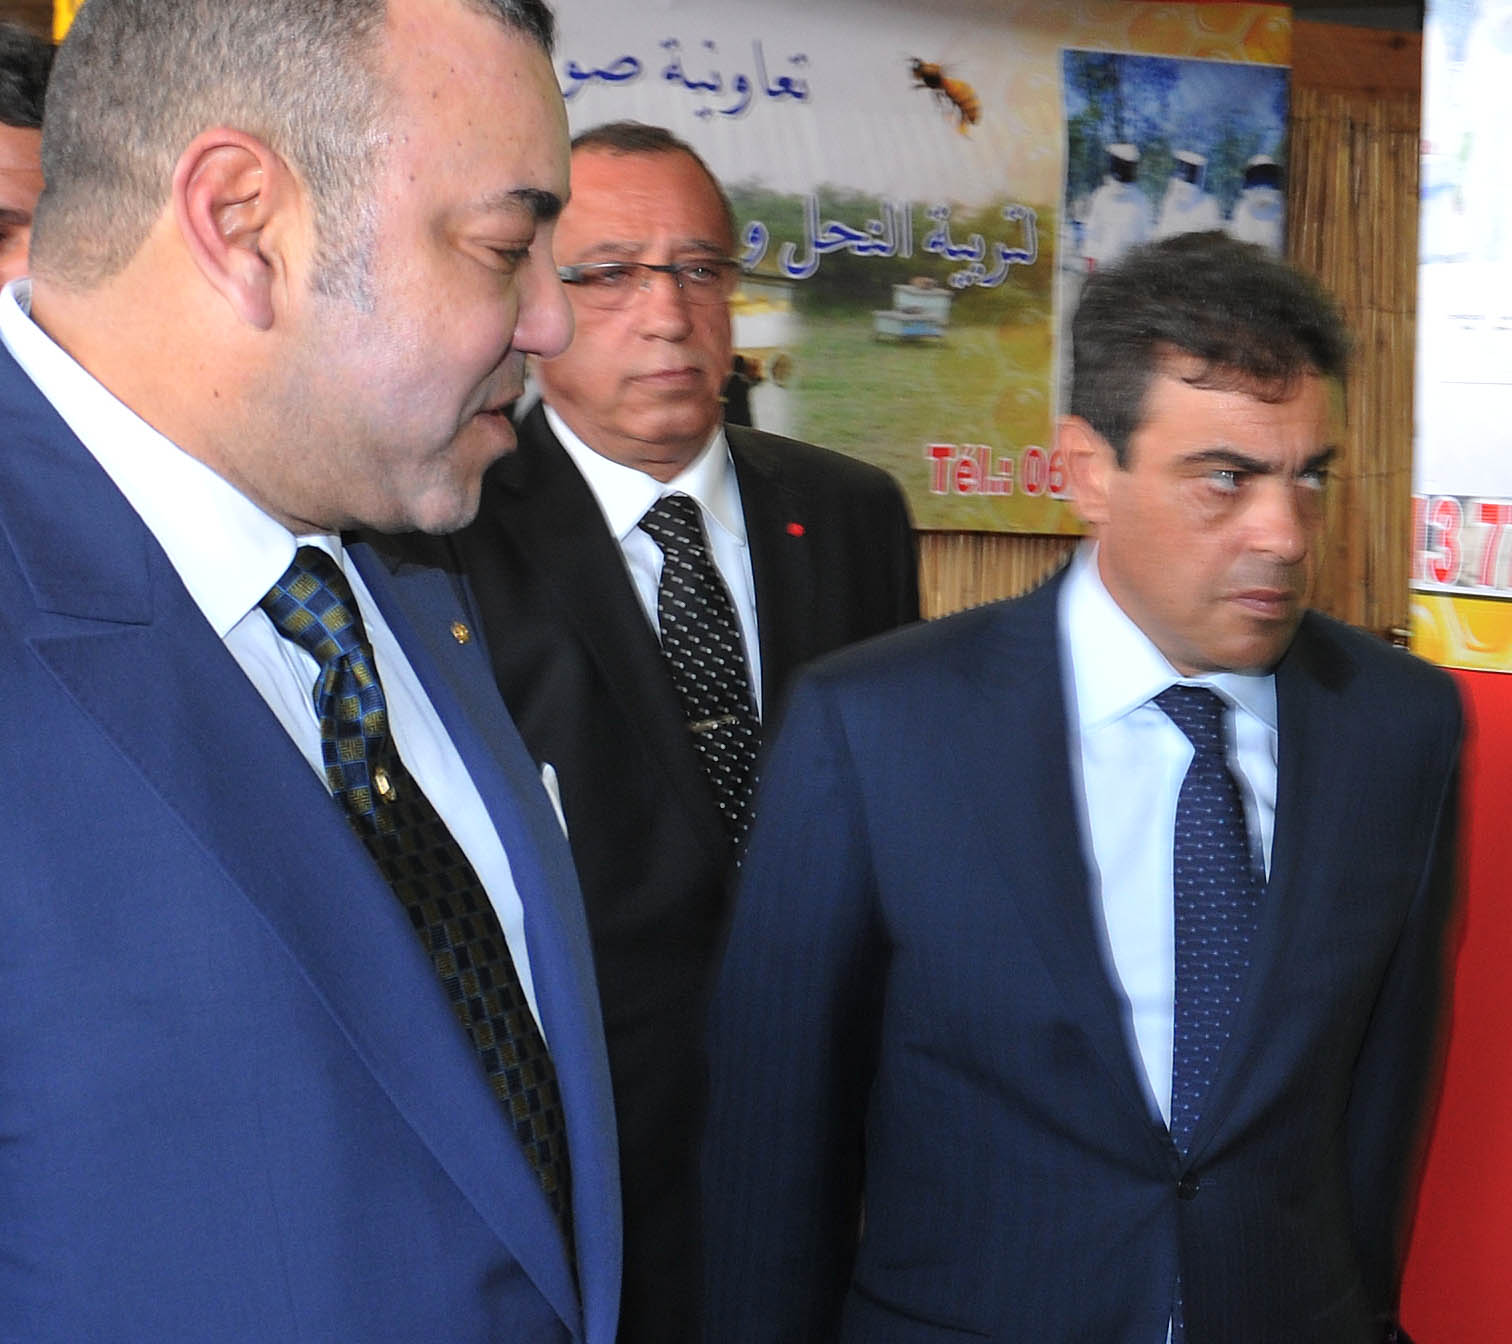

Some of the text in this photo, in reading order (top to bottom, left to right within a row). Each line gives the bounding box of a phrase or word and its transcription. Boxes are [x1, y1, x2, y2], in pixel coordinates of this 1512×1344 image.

[562, 36, 810, 118] تعاونية صو
[778, 193, 914, 280] النحل
